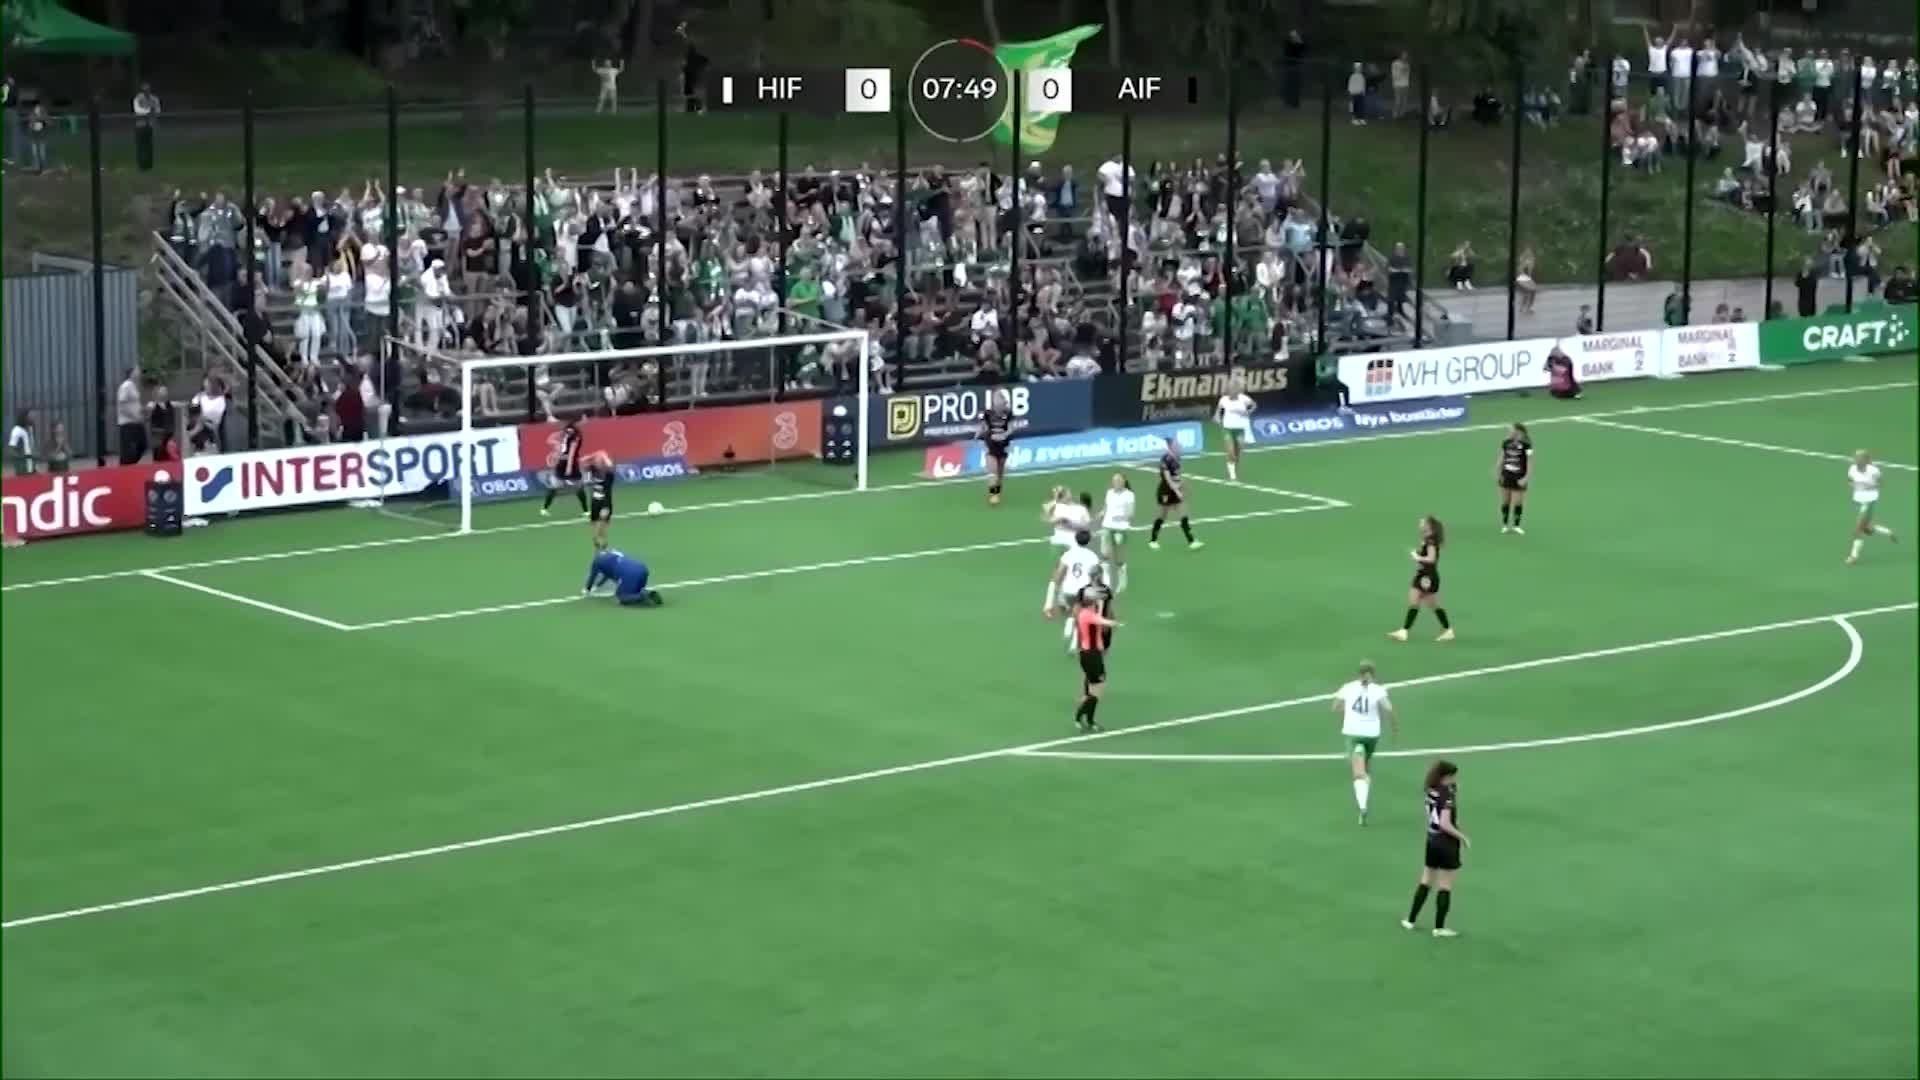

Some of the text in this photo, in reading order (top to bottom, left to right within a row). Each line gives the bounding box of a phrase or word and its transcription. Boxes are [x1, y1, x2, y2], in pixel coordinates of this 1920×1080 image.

[1803, 321, 1886, 351] CRAFT
[1399, 350, 1532, 388] WH GROUP
[1582, 361, 1616, 376] BANK
[1141, 367, 1288, 401] EkmanBuss
[1116, 428, 1195, 454] fotbll
[240, 437, 501, 500] INTERSPORT
[1351, 695, 1370, 715] 41
